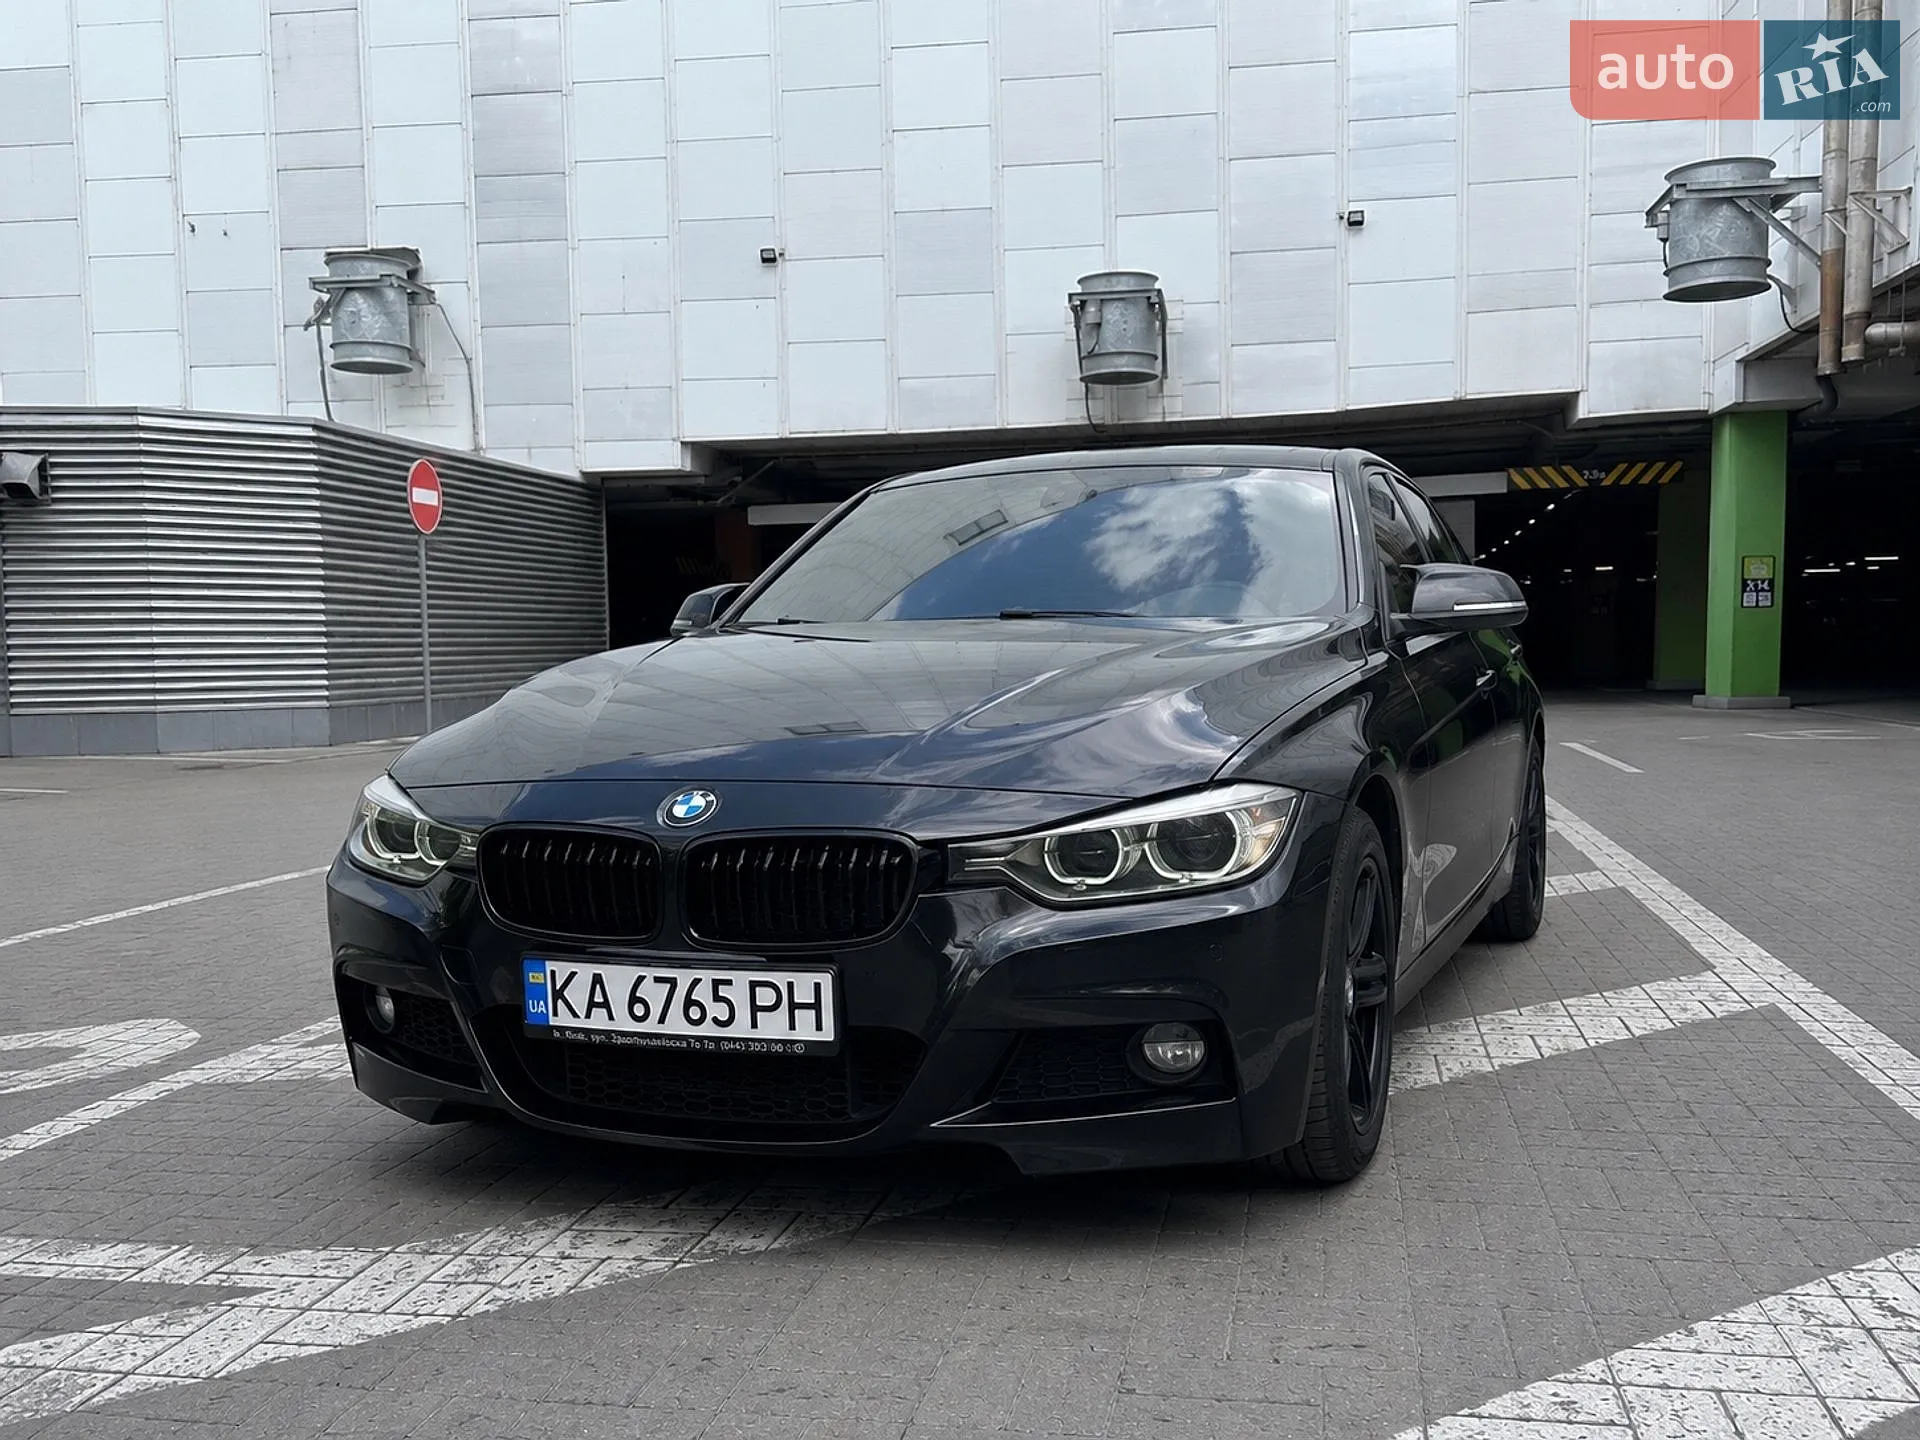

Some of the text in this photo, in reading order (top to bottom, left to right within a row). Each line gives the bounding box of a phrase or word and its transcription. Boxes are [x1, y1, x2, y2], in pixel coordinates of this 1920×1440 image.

[528, 999, 547, 1014] UA
[549, 968, 824, 1032] KA 6765 PH
